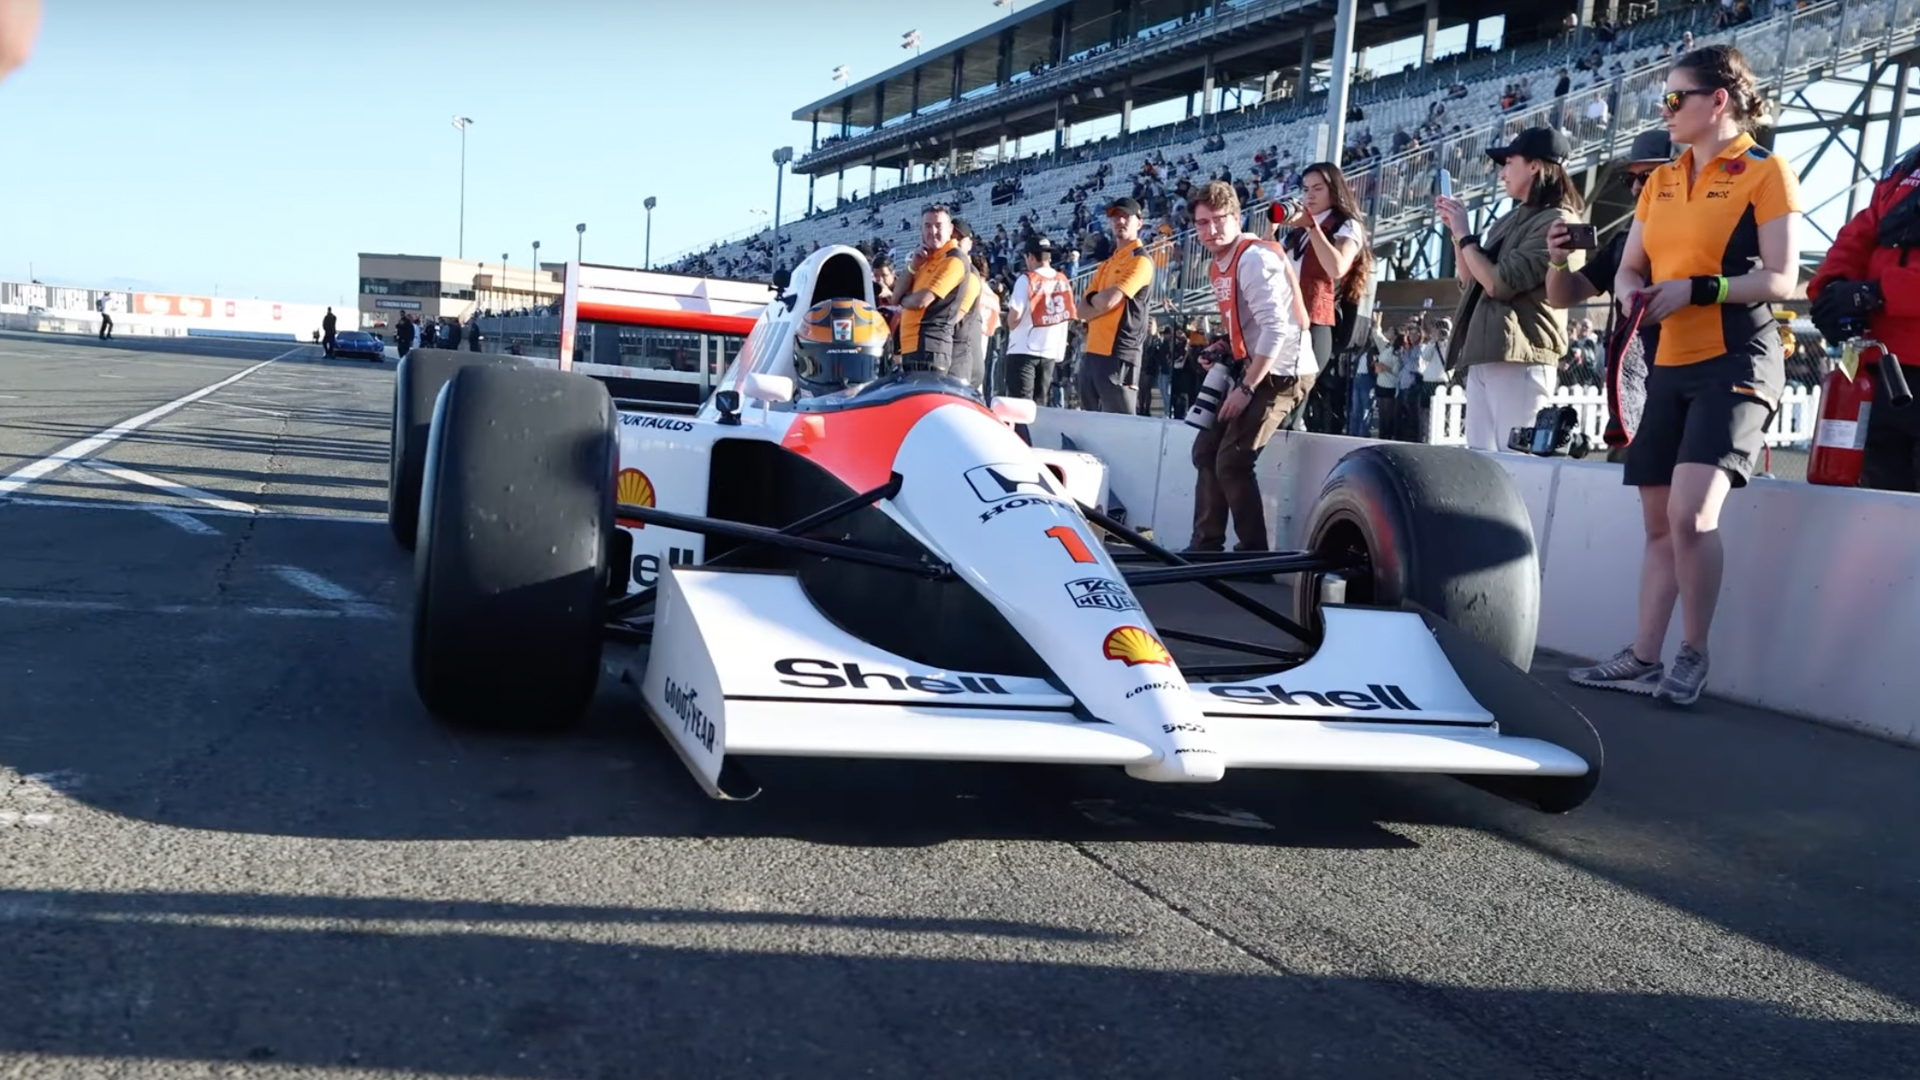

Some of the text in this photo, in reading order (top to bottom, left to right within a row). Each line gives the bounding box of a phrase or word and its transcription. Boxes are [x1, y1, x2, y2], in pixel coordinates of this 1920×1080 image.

[1042, 310, 1070, 325] PHOTO
[617, 413, 695, 432] OURTAULDS
[978, 497, 1076, 524] HOND
[1044, 526, 1099, 564] 1
[1075, 579, 1127, 596] TAG
[774, 658, 1012, 695] Shell
[1208, 684, 1423, 711] Shell
[665, 676, 716, 755] GOODYEAR
